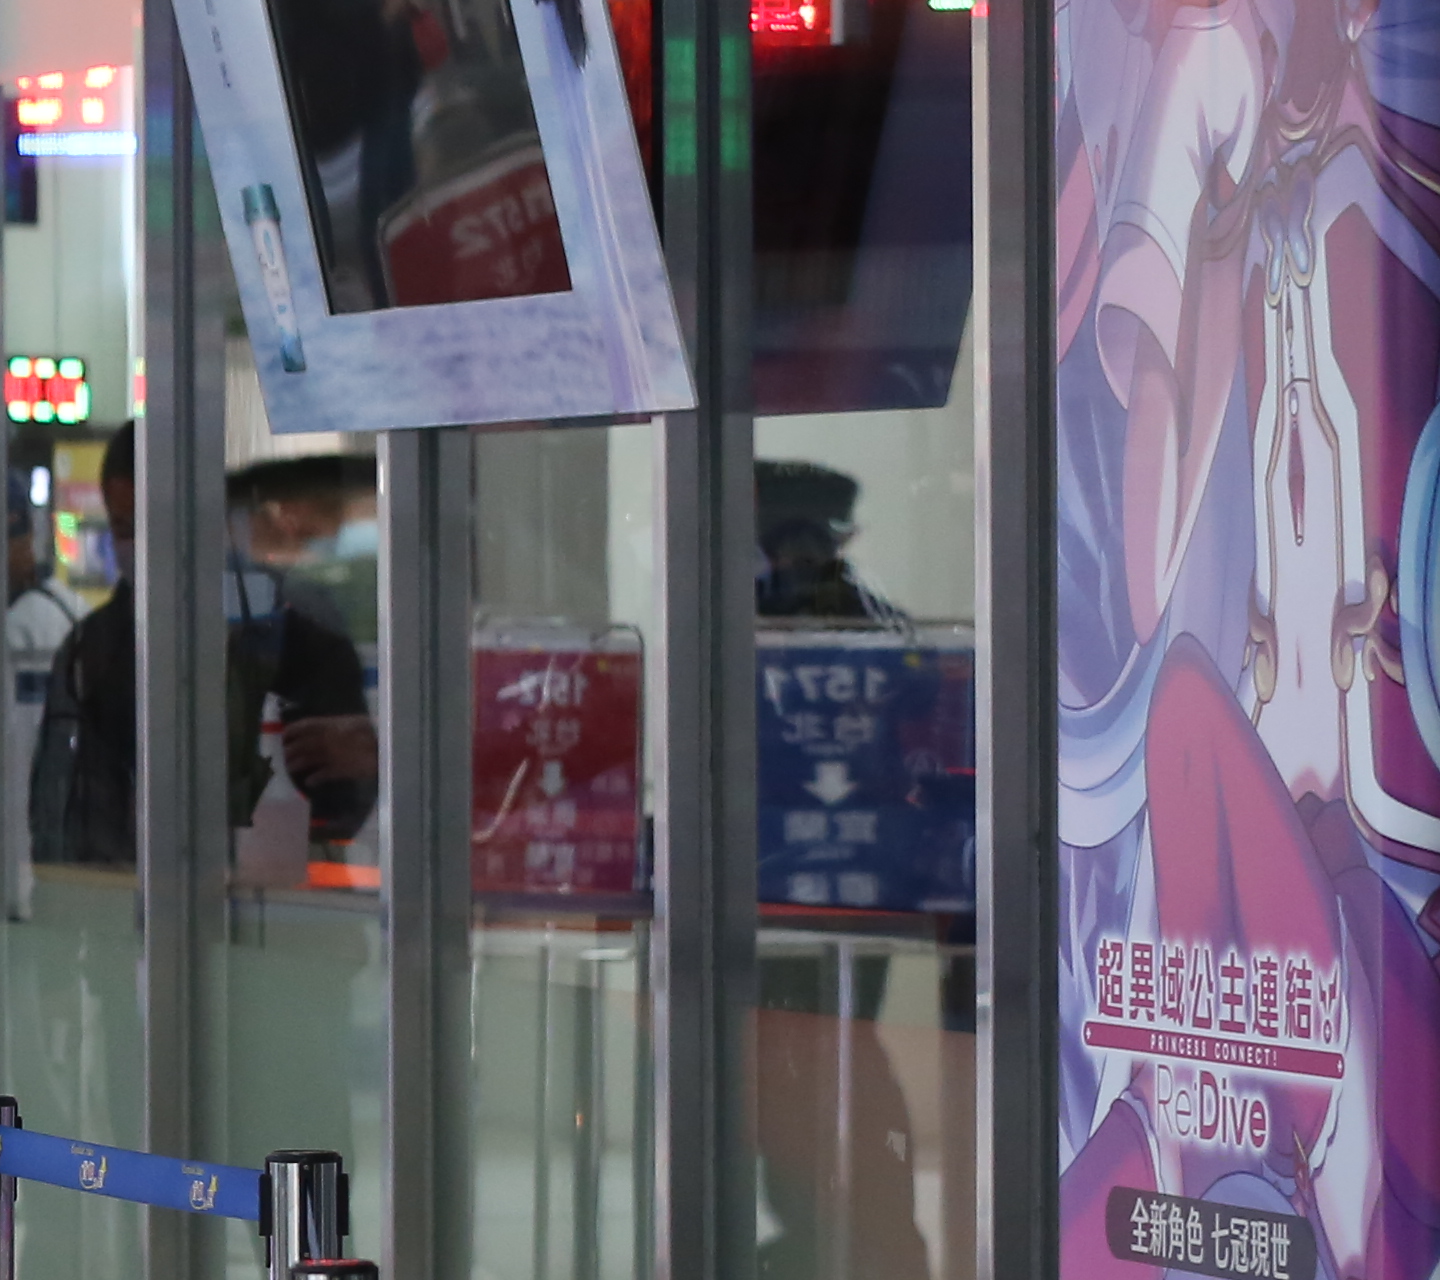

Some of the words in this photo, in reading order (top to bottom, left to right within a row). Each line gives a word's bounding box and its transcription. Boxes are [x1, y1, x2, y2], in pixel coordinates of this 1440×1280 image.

[1098, 938, 1312, 1039] 超異域公主連結
[1150, 1033, 1207, 1057] PRINCESS
[1214, 1041, 1278, 1066] CONNECT!
[1156, 1064, 1267, 1148] Re:Dive
[1130, 1197, 1204, 1265] 全新角色
[1210, 1212, 1291, 1280] 七冠現世
